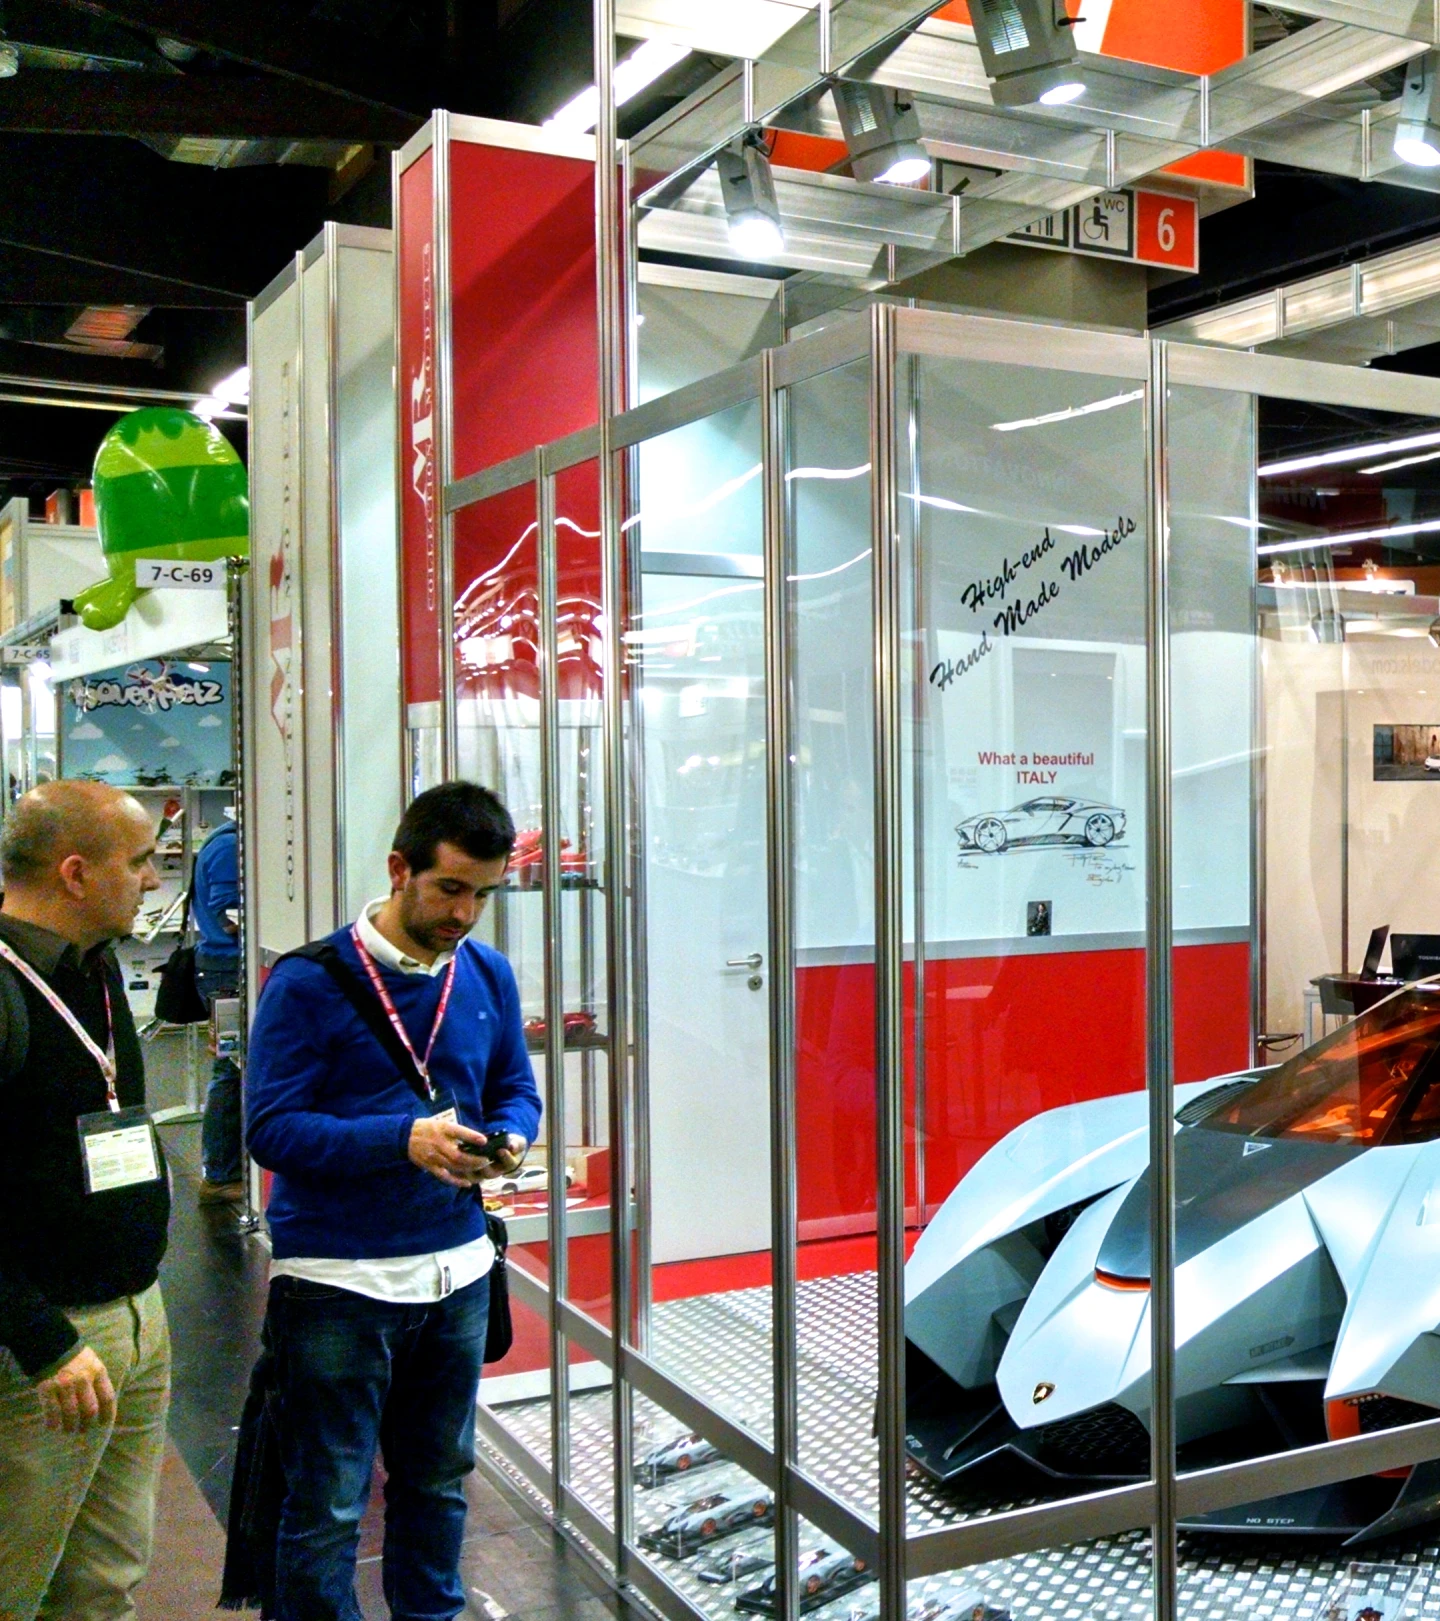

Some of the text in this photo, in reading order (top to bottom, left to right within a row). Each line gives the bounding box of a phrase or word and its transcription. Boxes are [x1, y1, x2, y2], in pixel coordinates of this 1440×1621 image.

[1103, 198, 1125, 212] WC
[1157, 208, 1176, 253] 6
[151, 565, 214, 584] 7-C-69
[959, 526, 1055, 614] High-end
[928, 515, 1137, 693] Hand Made Models
[12, 650, 50, 660] 7-C-65
[977, 751, 1095, 767] What a beautiful
[1016, 770, 1058, 785] ITALY
[1265, 1517, 1295, 1525] STEP
